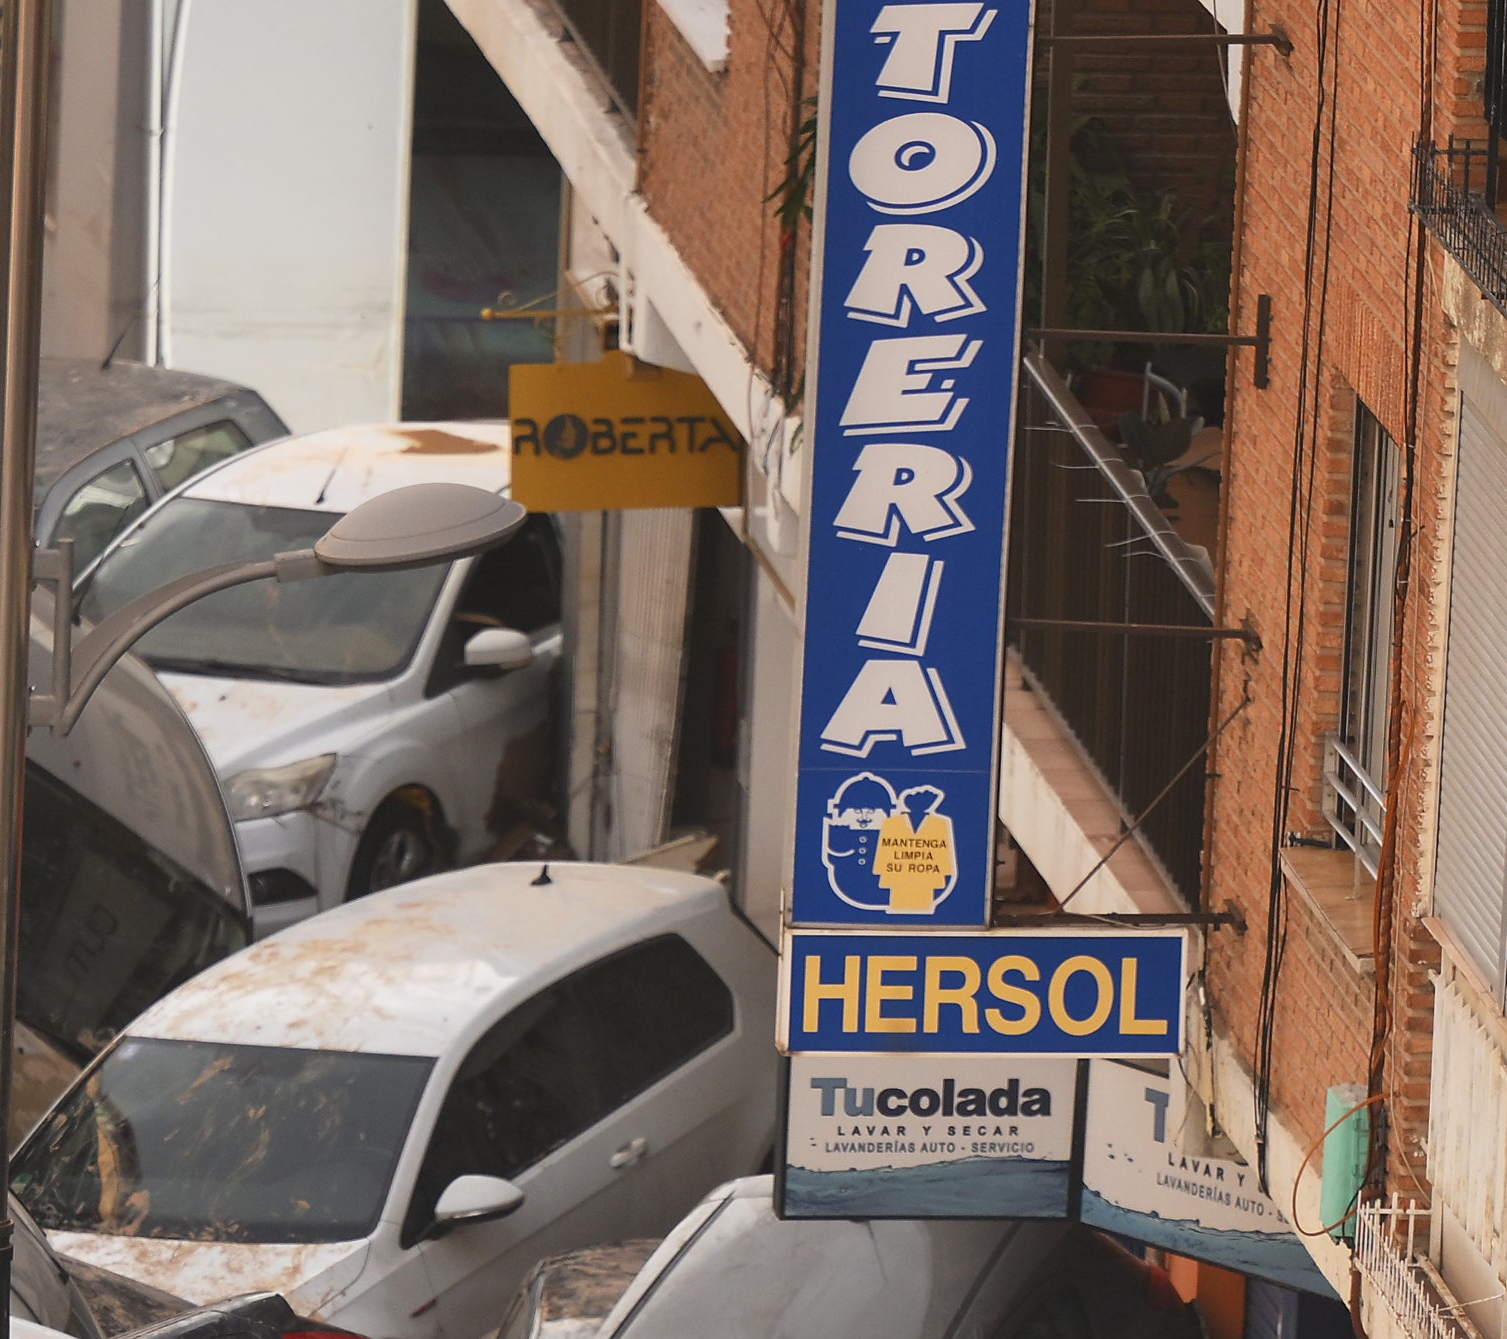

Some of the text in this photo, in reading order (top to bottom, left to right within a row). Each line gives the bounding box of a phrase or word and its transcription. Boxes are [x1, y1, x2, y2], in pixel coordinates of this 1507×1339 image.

[513, 414, 738, 460] ROBERTA
[881, 838, 947, 848] MANTENGA
[886, 863, 940, 873] SU ROPA
[893, 851, 934, 861] LIMPIA
[803, 954, 1170, 1039] HERSOL
[810, 1077, 1052, 1118] Tucolada
[836, 1124, 1021, 1138] LAVAR Y SECAR
[824, 1140, 917, 1155] LAVANDERÍAS
[920, 1142, 957, 1154] AUTO
[971, 1141, 1035, 1154] SERVICIO
[1167, 1152, 1246, 1185] LAVAR Y
[1156, 1170, 1232, 1208] LAVANDERÍAS
[1233, 1199, 1265, 1217] AUTO
